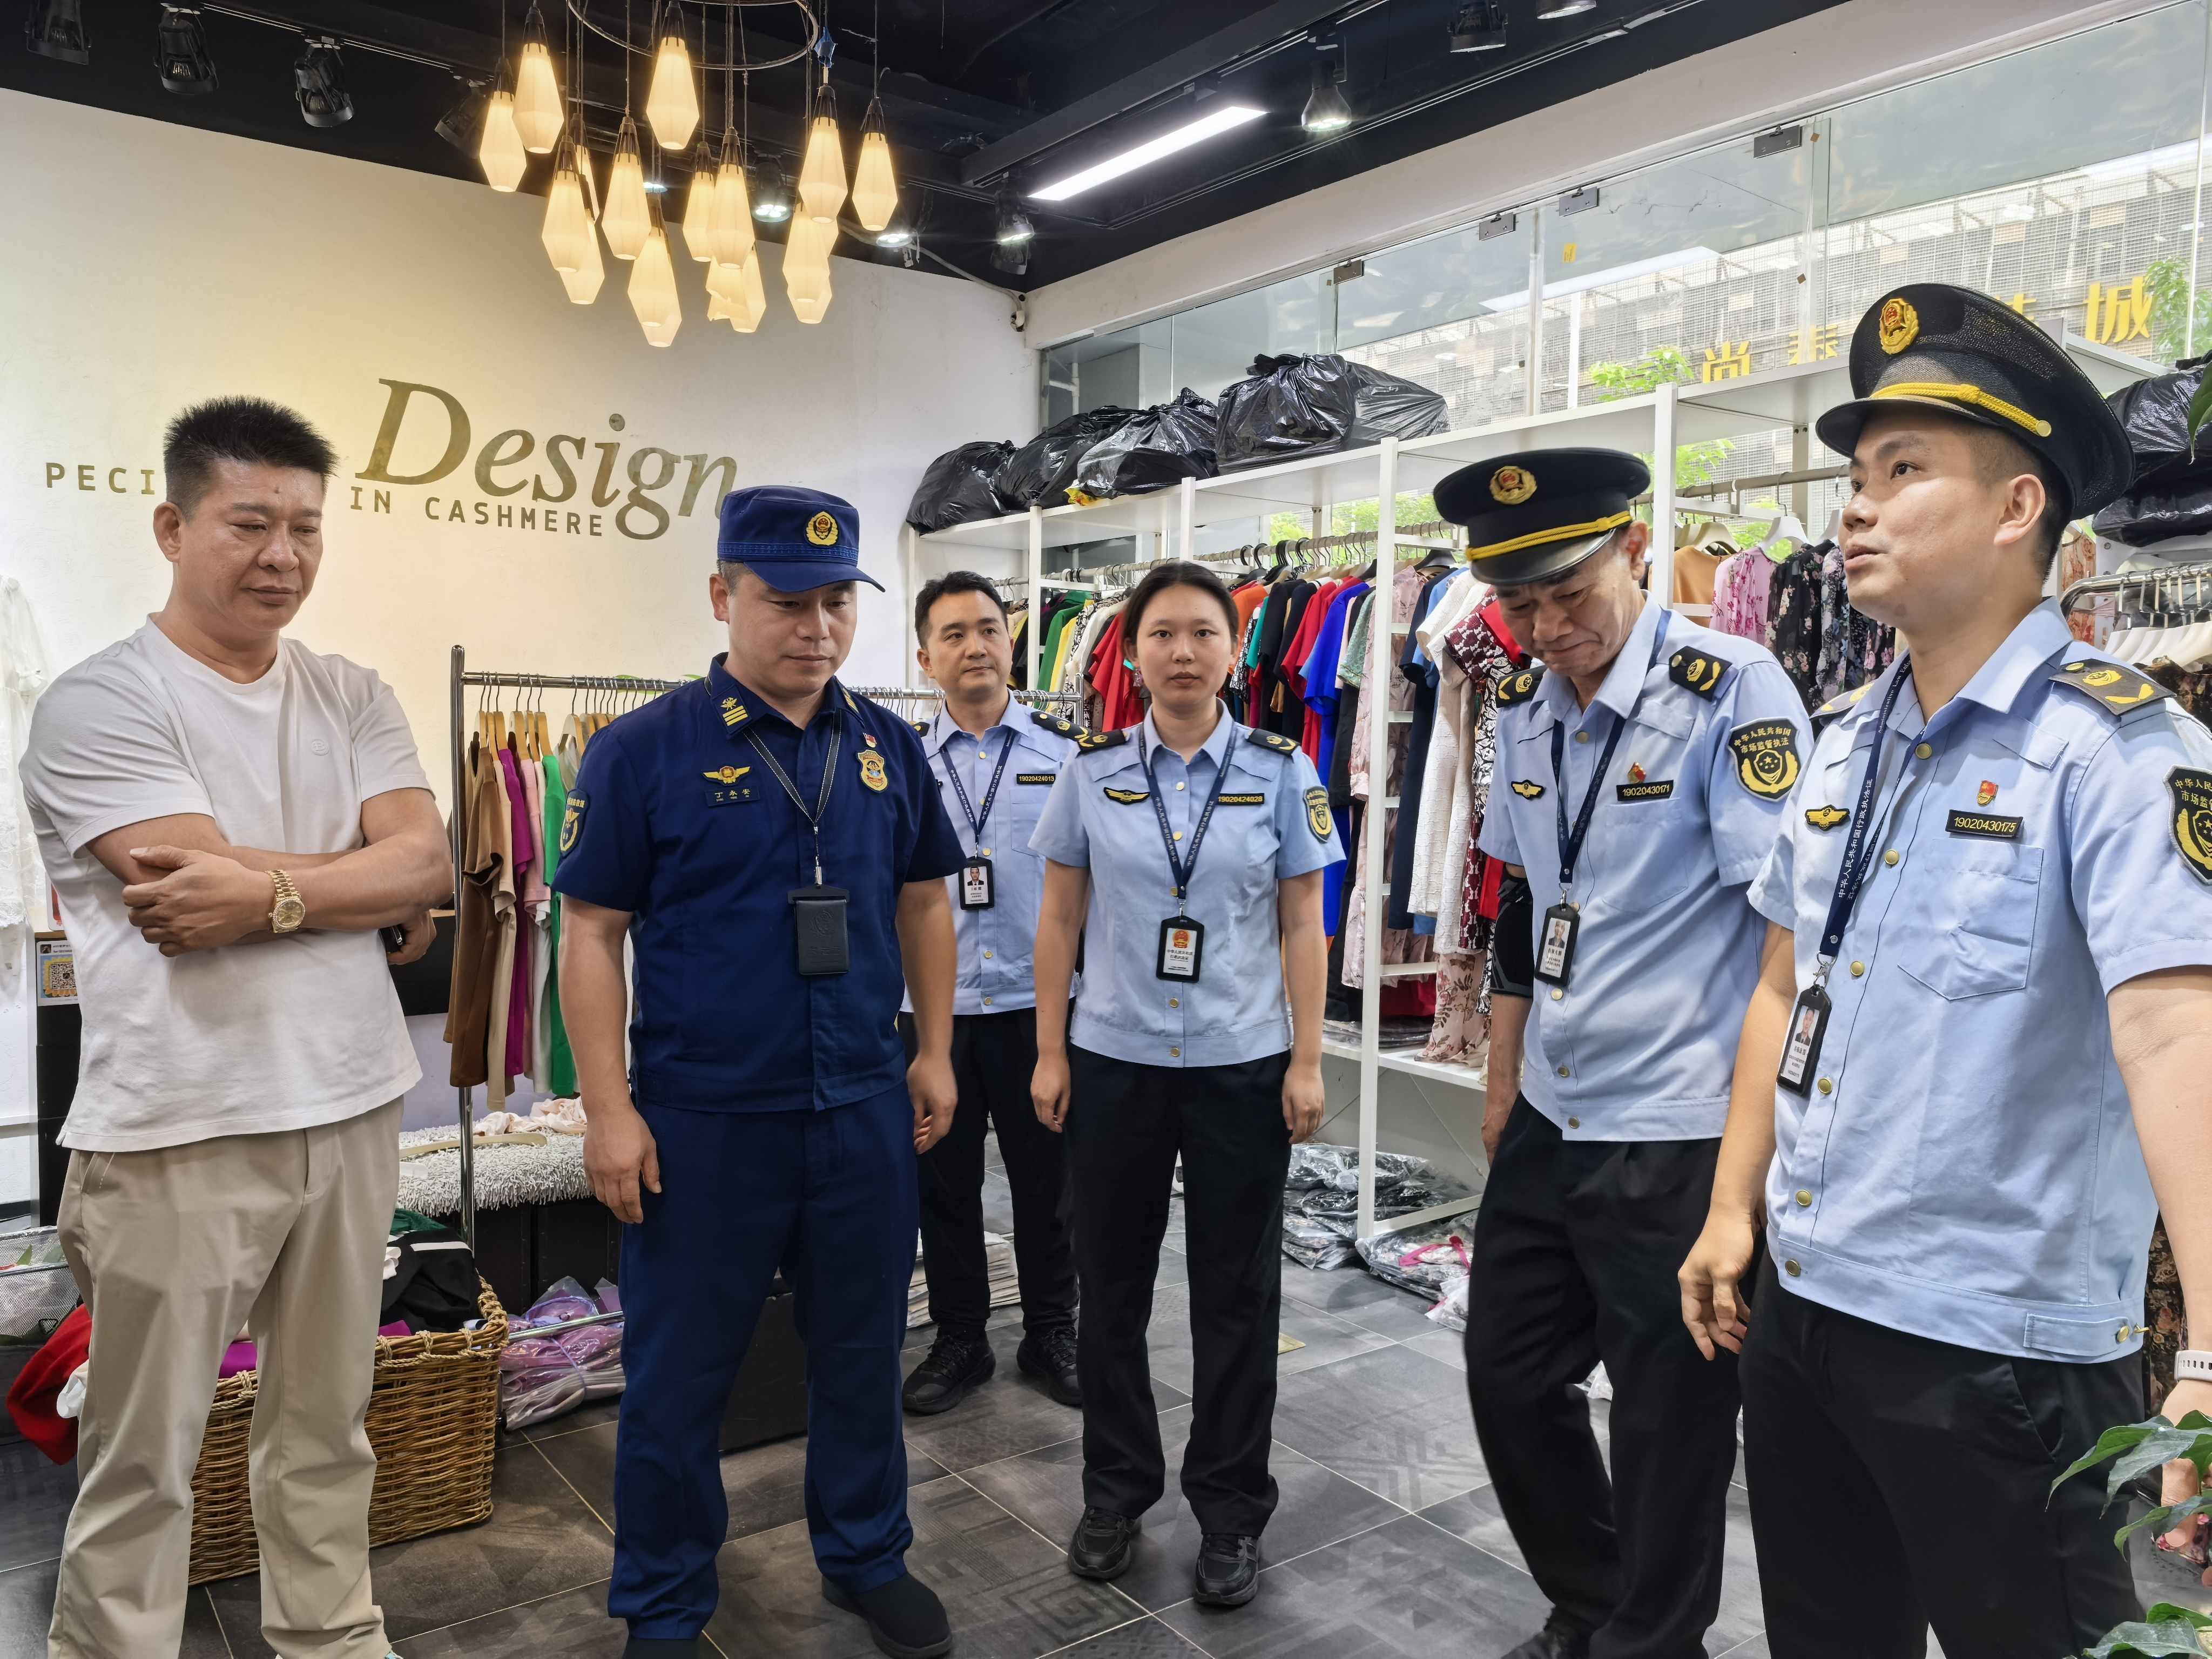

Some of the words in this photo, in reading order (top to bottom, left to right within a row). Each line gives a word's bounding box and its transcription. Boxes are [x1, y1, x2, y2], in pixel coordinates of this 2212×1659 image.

[355, 378, 738, 540] Design
[350, 486, 391, 514] IN
[426, 497, 602, 536] CASHMERE
[1892, 675, 1901, 687] Law
[1734, 727, 1791, 746] 中华人民共和国
[1740, 737, 1789, 753] 市场监管执法
[1622, 784, 1670, 797] 19020430171
[1954, 817, 2017, 832] 19020430175
[1838, 778, 1872, 899] 中华人民共和国行政执法证
